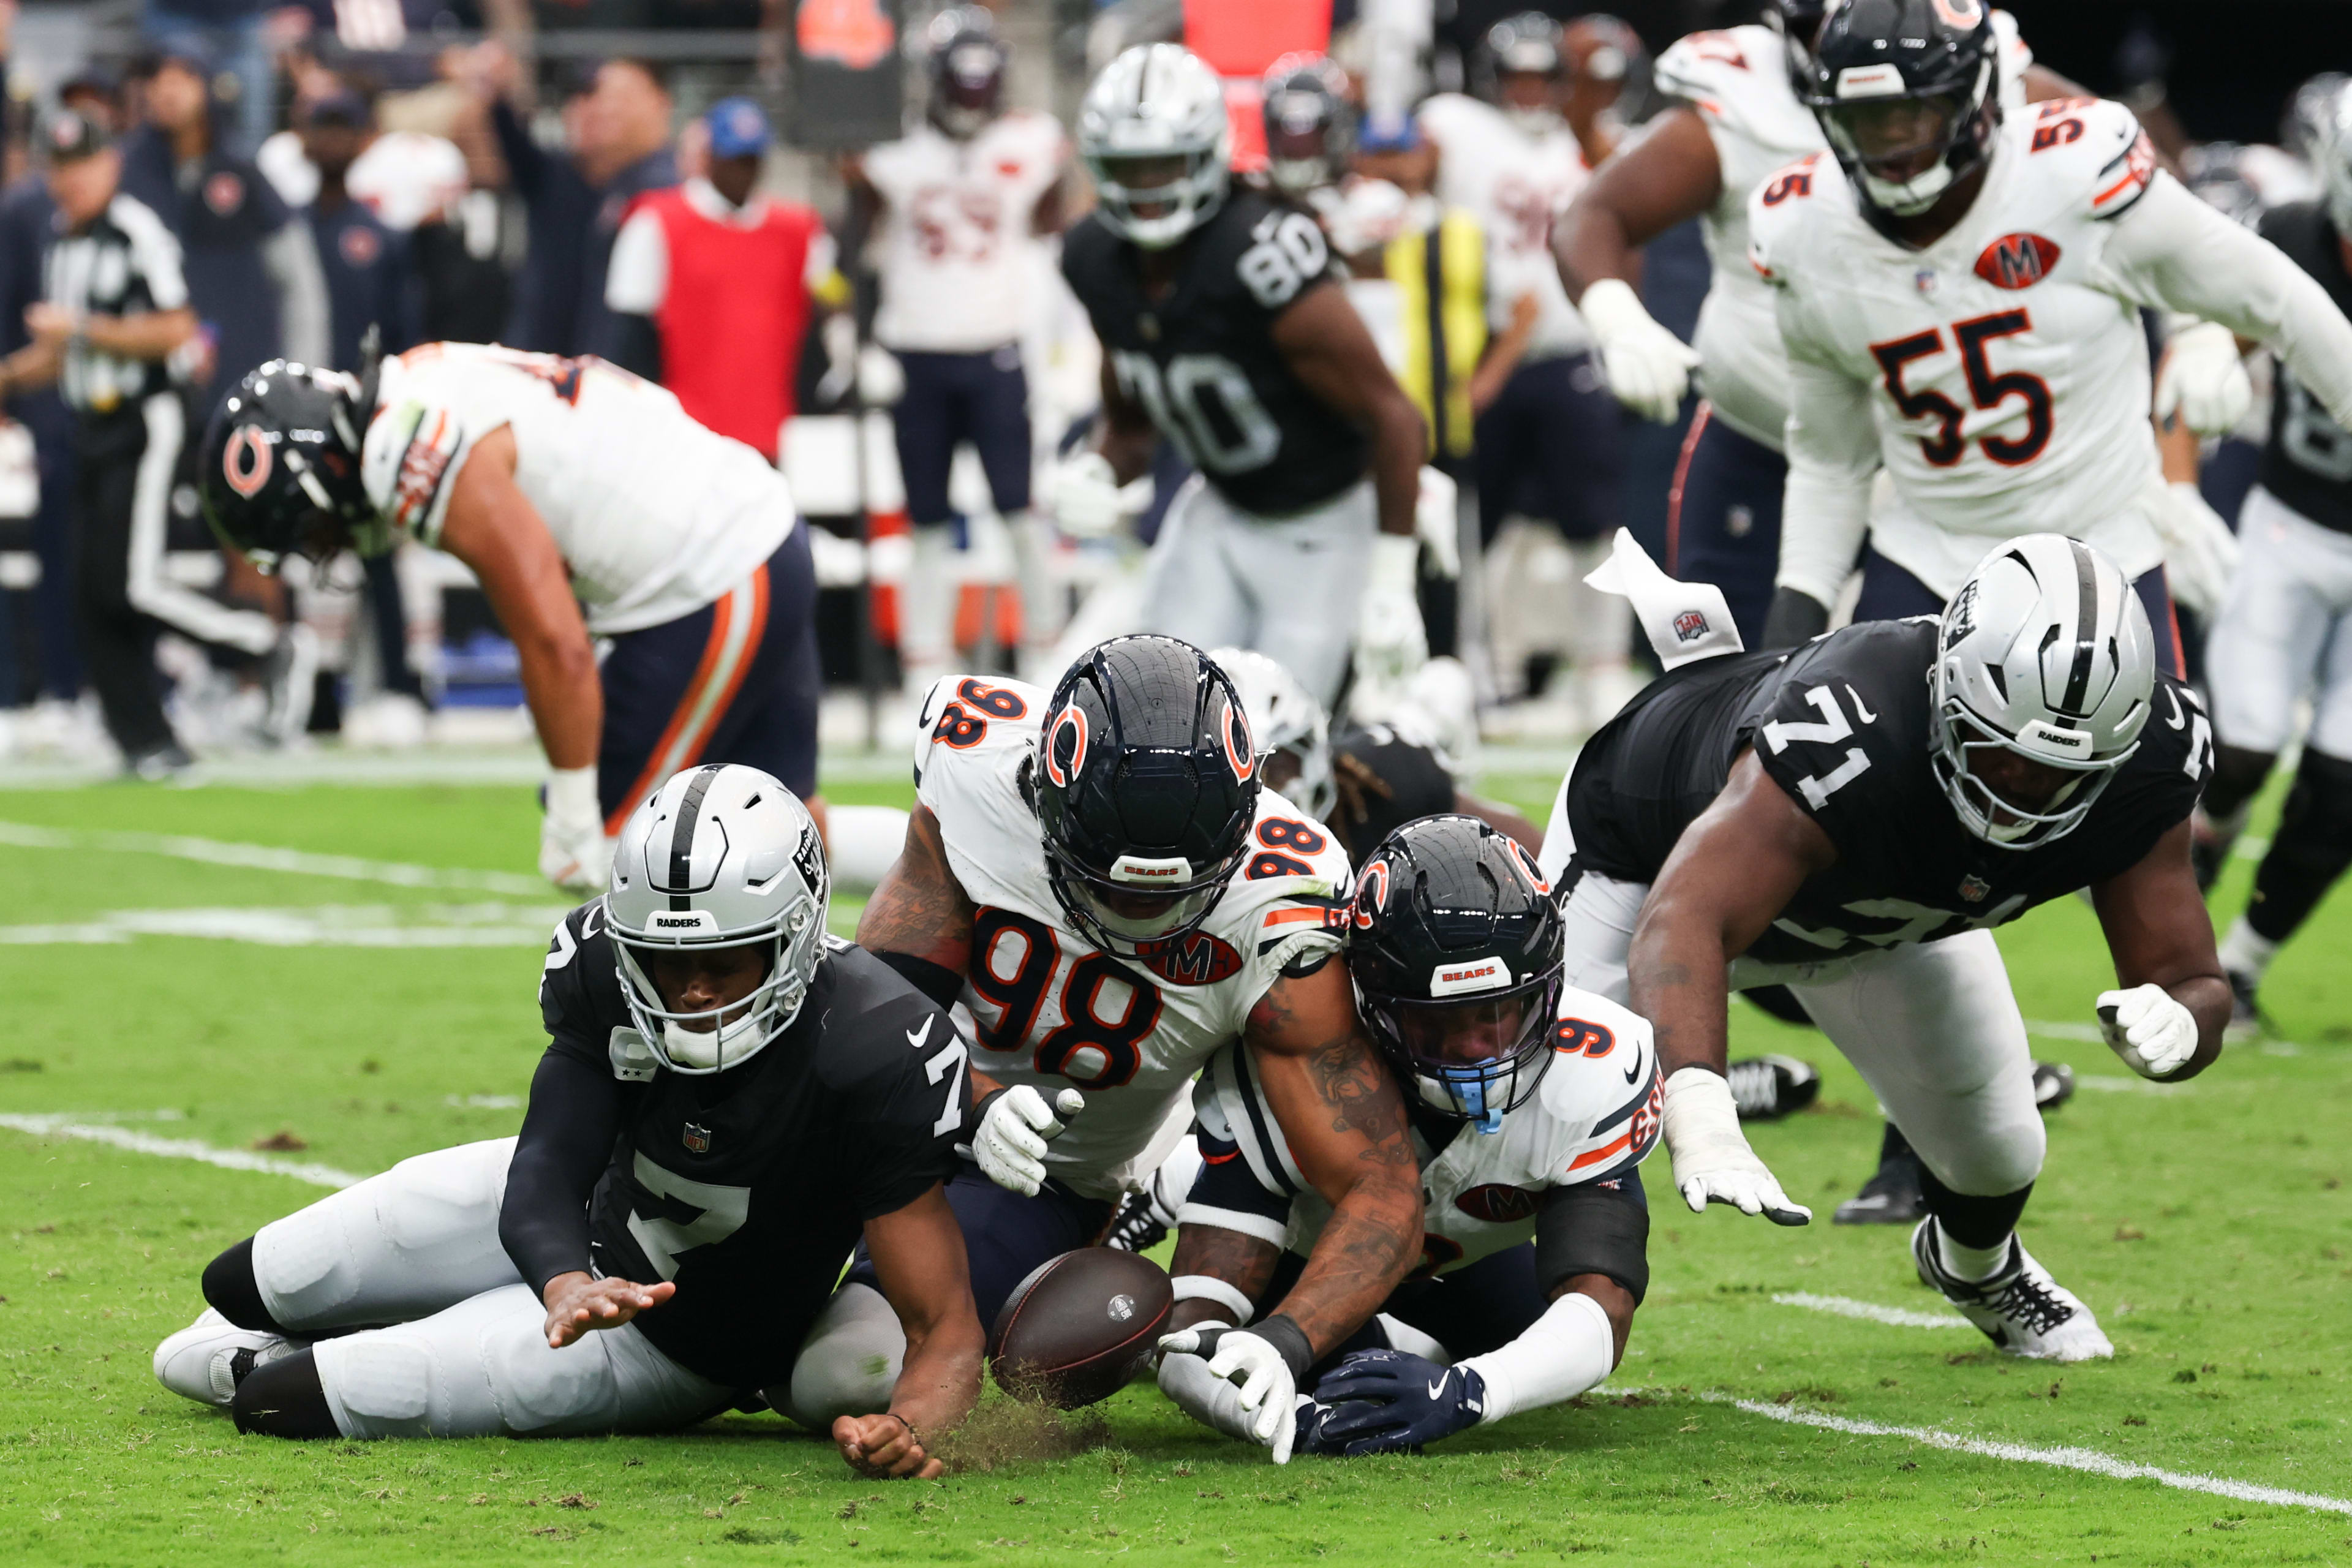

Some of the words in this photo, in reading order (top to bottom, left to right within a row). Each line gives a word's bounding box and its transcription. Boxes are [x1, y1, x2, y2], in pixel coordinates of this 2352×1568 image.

[1237, 212, 1328, 307] 80
[1869, 306, 2054, 467] 55
[932, 677, 1027, 749] 98
[1762, 685, 1871, 812] 71
[2037, 730, 2081, 748] RAIDERS
[1124, 864, 1179, 876] BEARS
[657, 918, 701, 927] RAIDERS
[970, 905, 1164, 1090] 98
[1442, 965, 1496, 982] BEARS
[925, 1033, 968, 1139] 7
[686, 1133, 707, 1150] NFL
[627, 1149, 752, 1281] 7
